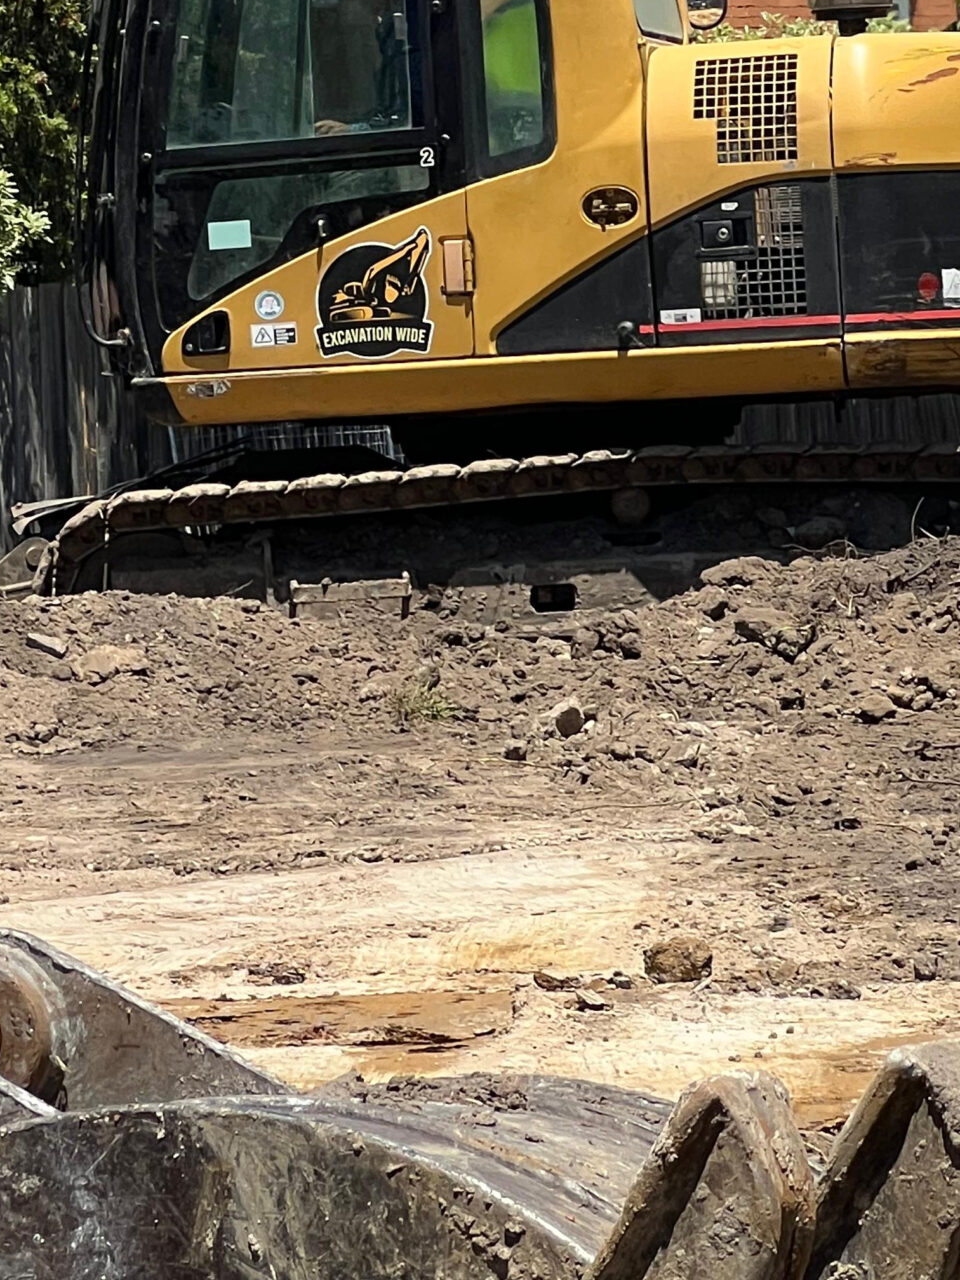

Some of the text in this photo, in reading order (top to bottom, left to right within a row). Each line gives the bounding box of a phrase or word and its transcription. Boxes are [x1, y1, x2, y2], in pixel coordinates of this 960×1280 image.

[420, 147, 435, 167] 2
[322, 326, 427, 348] EXCAVATION WIDE
